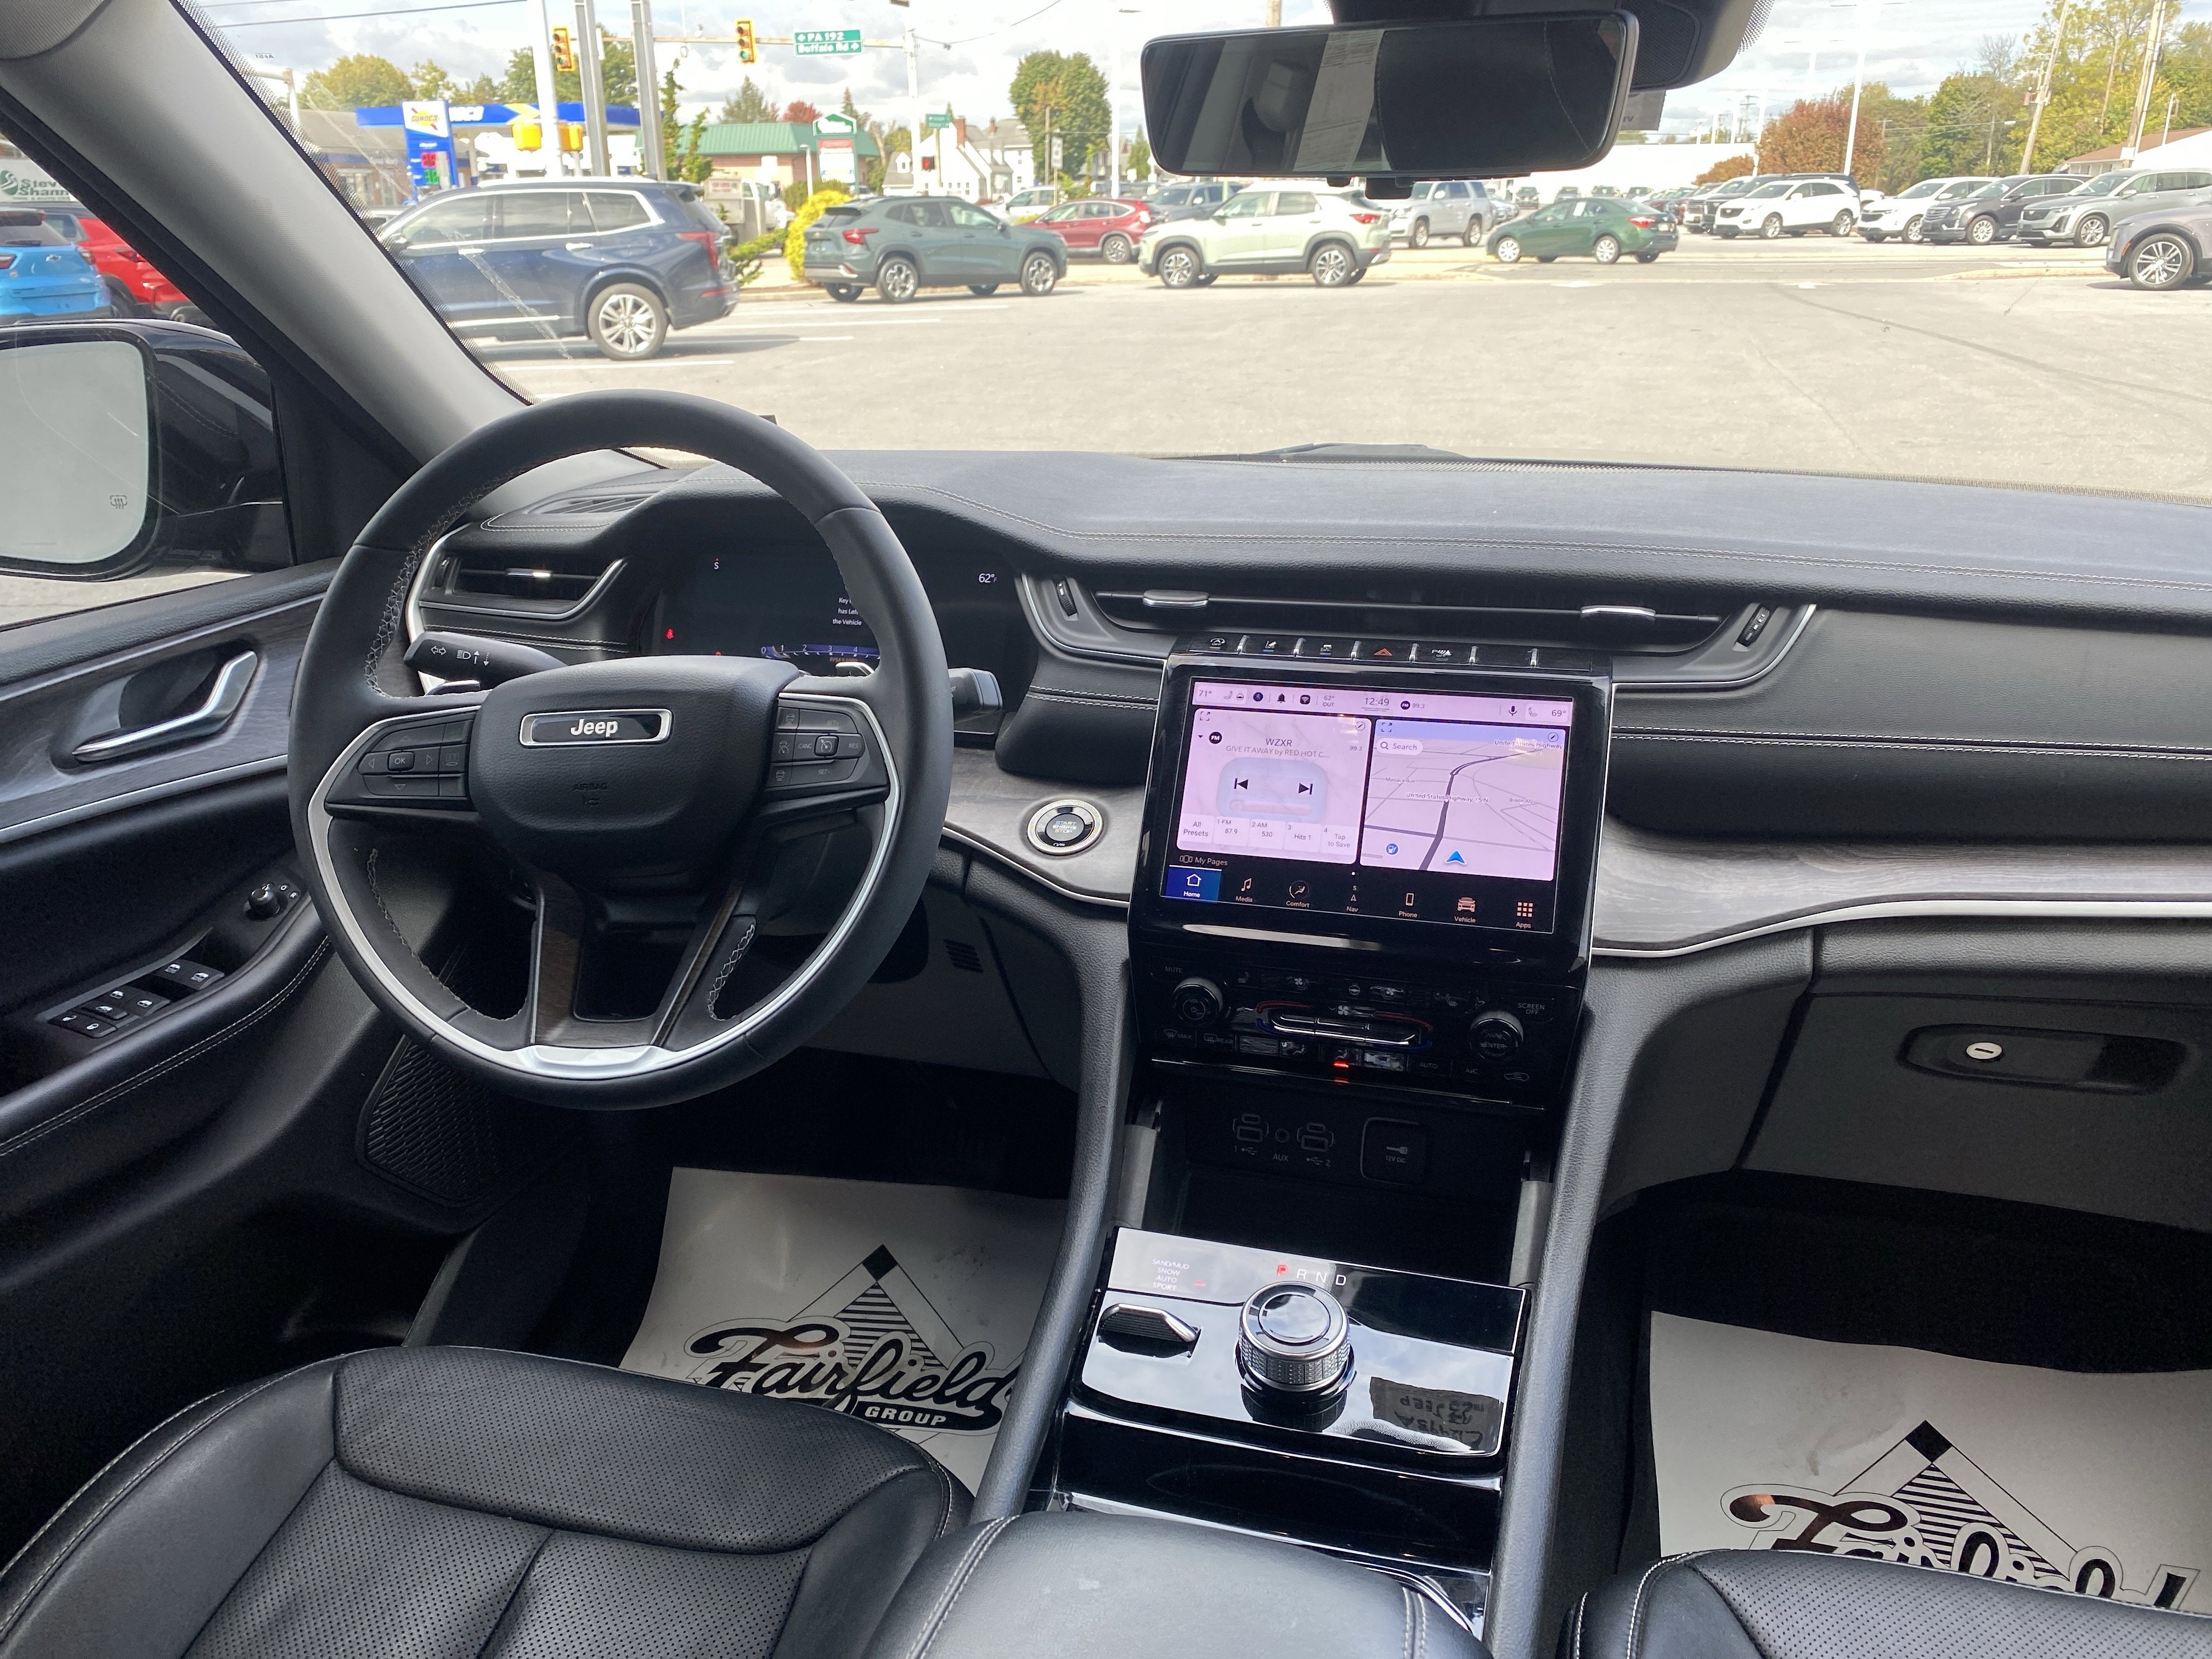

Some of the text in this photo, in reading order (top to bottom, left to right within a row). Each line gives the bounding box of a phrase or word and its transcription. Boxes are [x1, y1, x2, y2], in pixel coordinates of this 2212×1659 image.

[807, 33, 822, 42] PA
[1364, 697, 1390, 707] 12:49
[570, 718, 618, 738] Jeep
[1265, 737, 1293, 747] WZXR
[1392, 743, 1417, 751] Search
[1447, 794, 1474, 803] Highway
[1183, 829, 1209, 837] Presets
[1194, 856, 1228, 866] My Pages
[1454, 916, 1476, 924] Vehicle
[1165, 966, 1184, 974] MUTE
[1273, 1153, 1289, 1161] AUX
[1152, 1259, 1189, 1269] SAND/MUD
[1157, 1267, 1181, 1276] SNOW
[1277, 1265, 1347, 1286] P R N D
[1155, 1275, 1177, 1284] AUTO
[1152, 1282, 1177, 1291] SPORT
[690, 1323, 1022, 1417] Fairfield
[864, 1405, 947, 1426] GROUP
